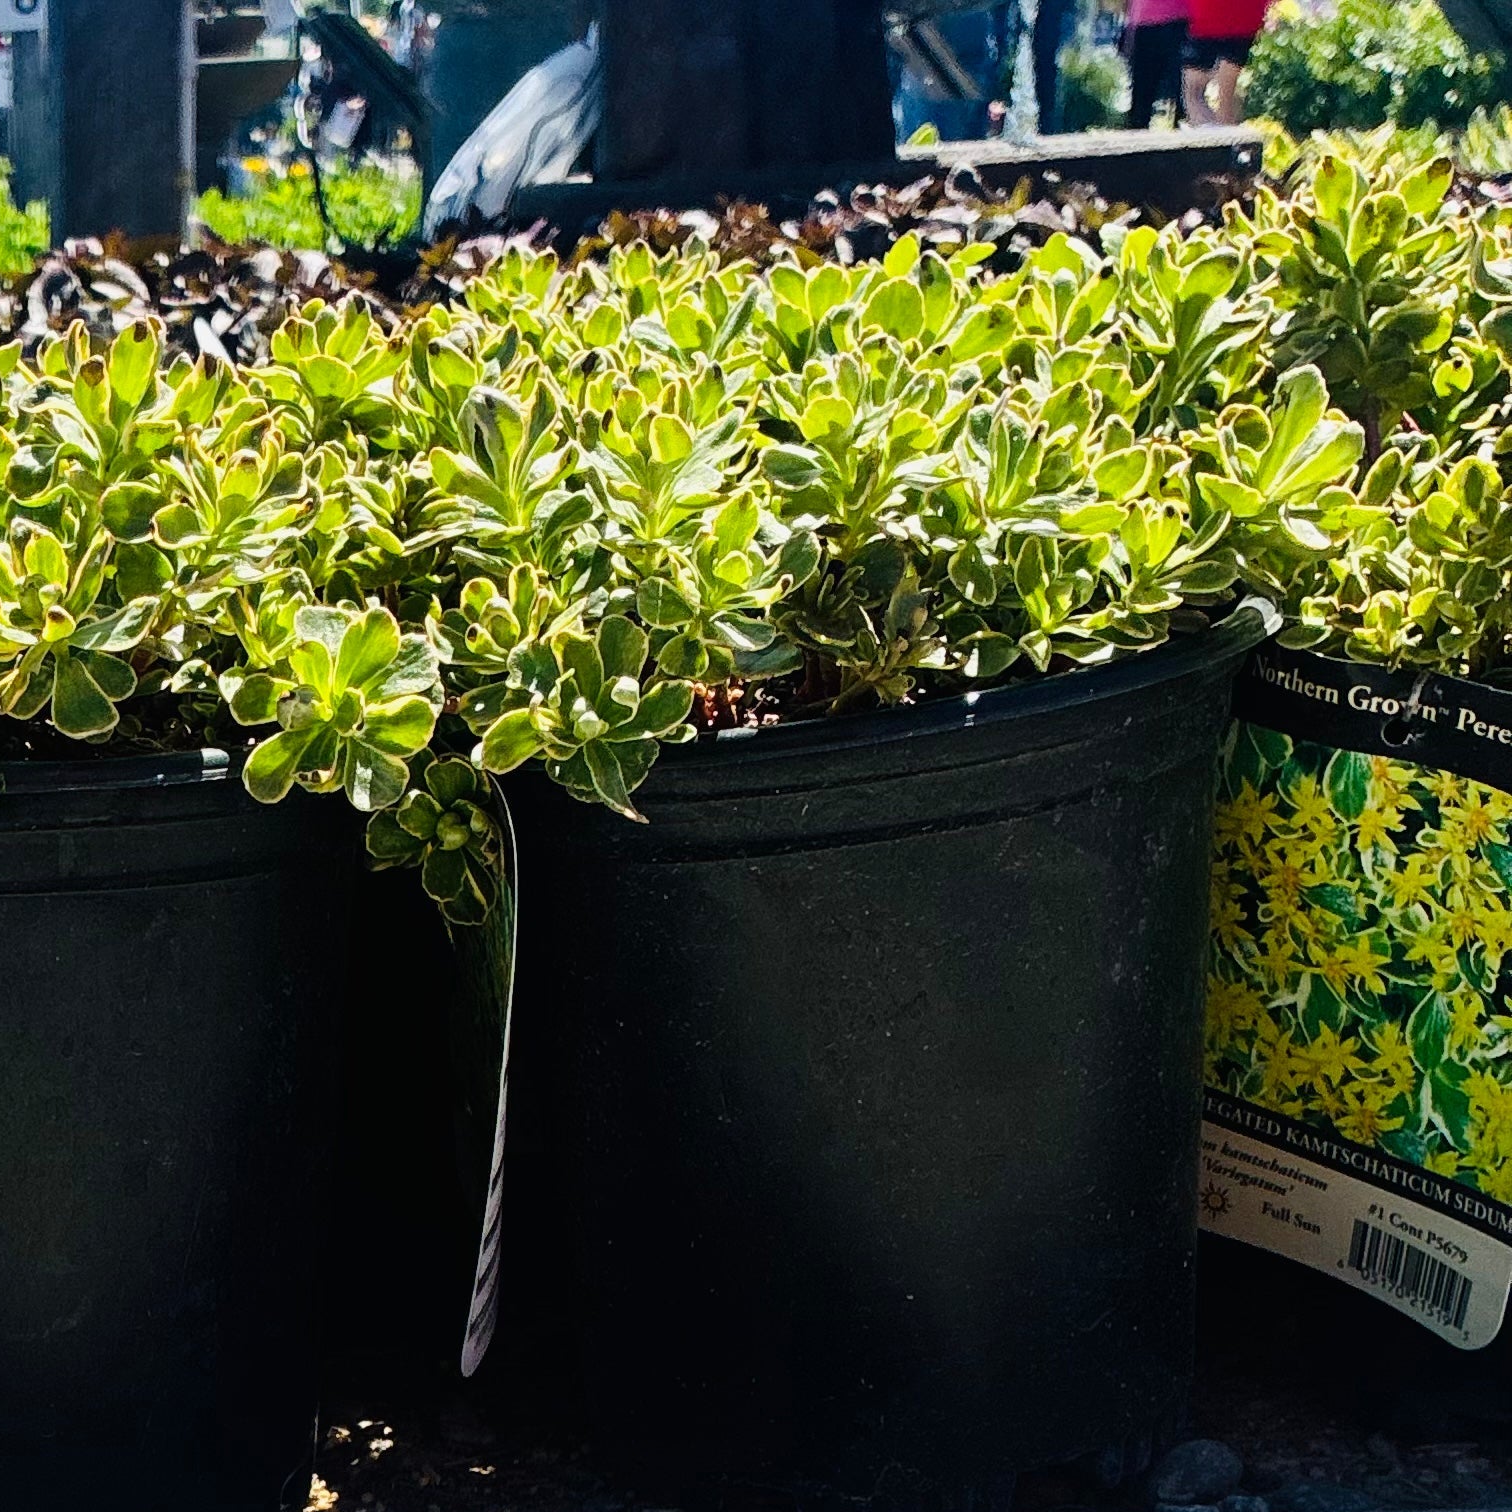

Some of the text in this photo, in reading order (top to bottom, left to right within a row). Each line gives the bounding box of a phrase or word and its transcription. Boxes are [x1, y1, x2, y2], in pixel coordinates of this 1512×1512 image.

[1252, 653, 1339, 705] Northern
[1455, 708, 1512, 745] Pere
[1219, 1140, 1328, 1192] kamtschaticum
[1286, 1126, 1452, 1206] KAMTSCHATICUM
[1453, 1192, 1512, 1235] SEDUM
[1261, 1200, 1321, 1234] Full Sun
[1368, 1203, 1469, 1264] #1 Cont P5679
